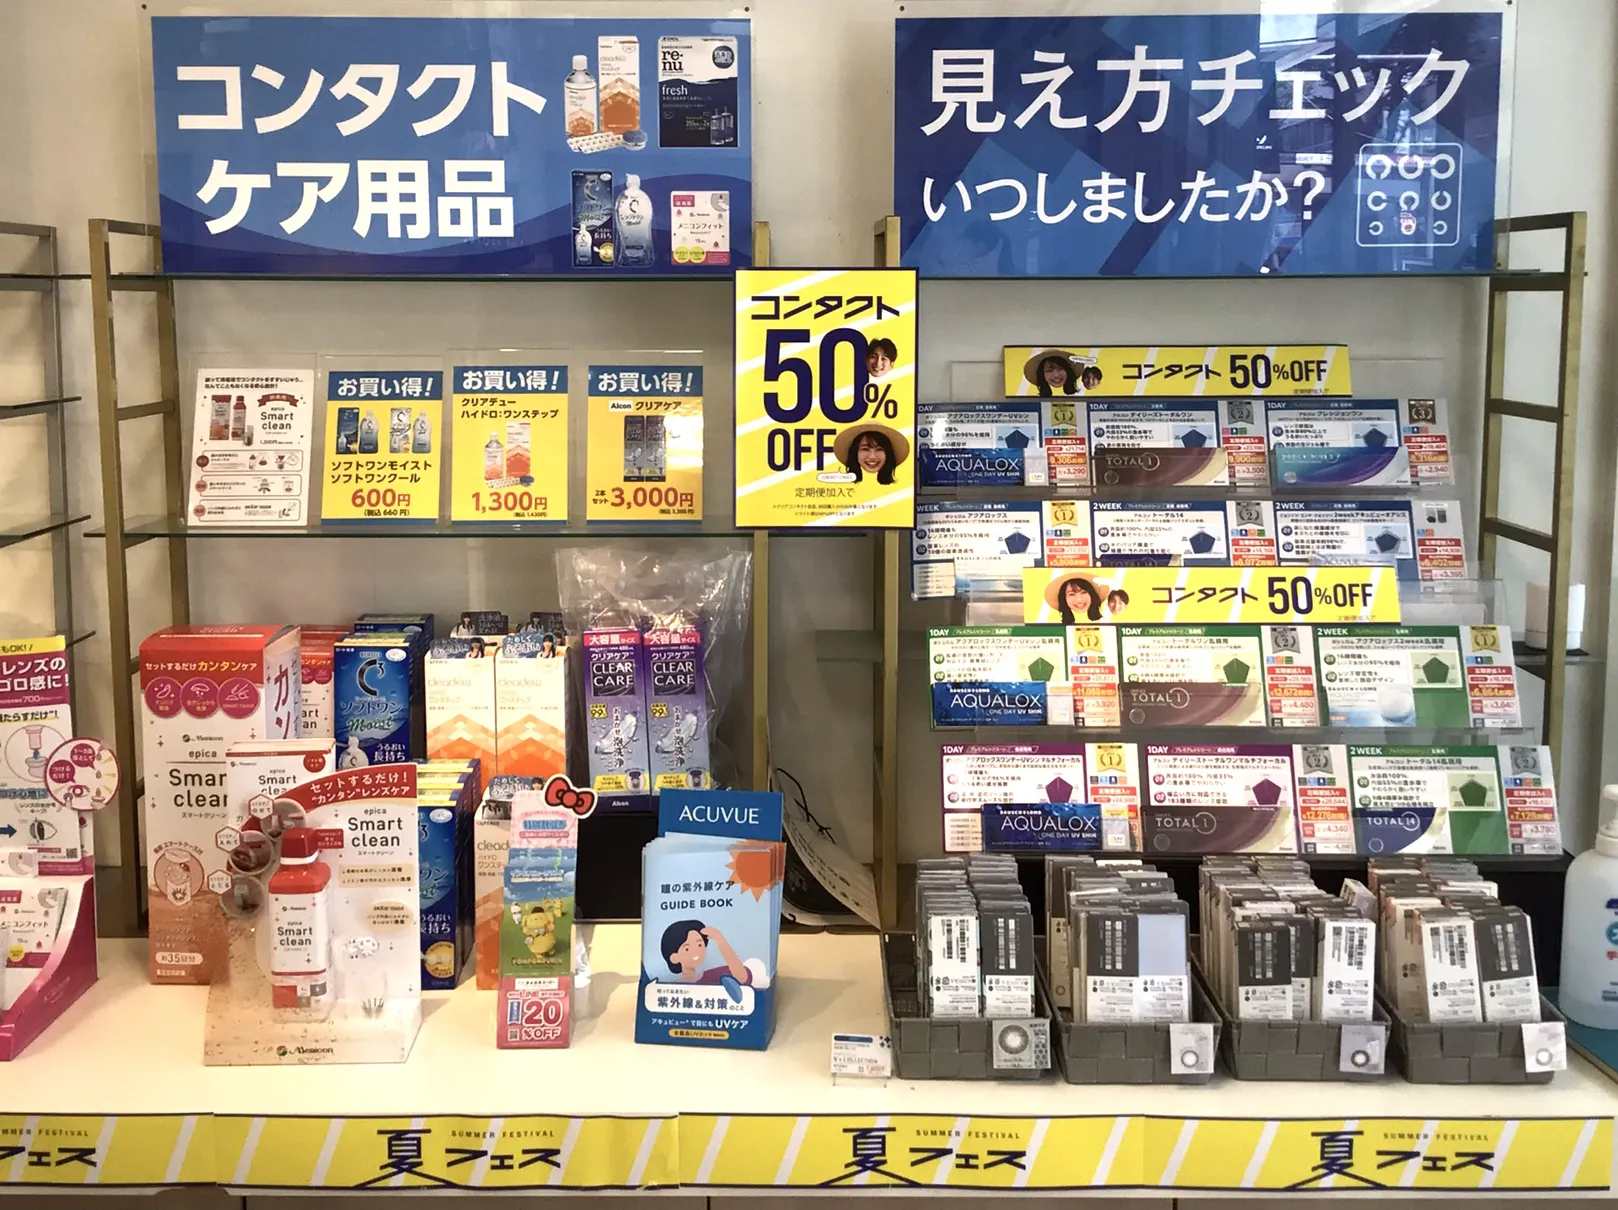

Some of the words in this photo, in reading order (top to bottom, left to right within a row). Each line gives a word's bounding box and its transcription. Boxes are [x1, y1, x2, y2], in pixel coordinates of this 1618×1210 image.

[661, 61, 684, 71] nu
[662, 84, 688, 95] fresh
[920, 44, 1469, 134] 見え方チェック
[176, 61, 547, 137] コンタクト
[195, 159, 514, 239] ケア用品
[923, 168, 1325, 223] いつしましたか?
[751, 295, 900, 320] コンタクト
[1122, 363, 1221, 380] コンタクト
[1229, 354, 1328, 390] 50%OFF
[463, 370, 559, 390] お買い得!
[598, 372, 693, 392] お買い得!
[338, 377, 433, 397] お買い得!
[461, 398, 516, 407] クリアデュー
[611, 402, 632, 410] Alcon
[635, 401, 682, 410] クリアケア
[261, 412, 293, 421] Smart
[767, 428, 836, 472] OFF
[331, 460, 432, 471] ソフトワンモイスト
[935, 458, 1020, 471] AQUALOX
[1106, 457, 1143, 465] TOTAL
[331, 473, 421, 483] ソフトワンクール
[351, 488, 410, 507] 600円
[611, 487, 694, 509] 3,000円
[795, 487, 854, 498] 定期便加入で
[471, 491, 547, 513] 1,300円
[917, 503, 939, 511] WEEK
[1093, 502, 1122, 510] 2WEEK
[1152, 586, 1258, 604] コンタクト
[1267, 576, 1373, 615] 50%OFF
[1122, 627, 1142, 635] 1DAY
[589, 633, 636, 645] 大容量サイズ
[649, 633, 697, 644] 大容量サイズ
[590, 652, 630, 661] クリアケア
[651, 652, 690, 660] クリアケア
[3, 657, 66, 676] レンズの
[145, 661, 258, 674] セットするだけカンタンケア
[592, 662, 633, 674] CLEAR
[653, 662, 694, 674] CLEAR
[427, 678, 472, 687] cleadew
[497, 678, 541, 687] cleadew
[593, 674, 634, 686] CARE
[654, 674, 695, 686] CARE
[22, 694, 41, 703] 700
[950, 693, 1042, 708] AQUALOX
[1132, 693, 1171, 703] TOTAL
[340, 701, 404, 717] ソフトワン
[346, 716, 394, 733] Moist
[376, 743, 406, 751] うるおい
[1147, 746, 1168, 754] 1DAY
[1350, 747, 1382, 755] 2WEEK
[189, 749, 217, 760] epica
[373, 751, 406, 762] 長持ち
[169, 768, 227, 787] Smar
[258, 773, 297, 785] Smart
[363, 807, 387, 816] epica
[679, 804, 760, 824] ACUVUE
[347, 816, 403, 832] Smart
[1001, 815, 1097, 831] AQUALOX
[1155, 817, 1197, 828] TOTAL
[1367, 817, 1404, 826] TOTAL
[1406, 817, 1415, 826] 14
[351, 833, 400, 848] clean
[477, 840, 509, 851] clead
[660, 879, 735, 894] 瞳の紫外線ケア
[660, 900, 695, 911] GUIDE
[700, 898, 734, 908] BOOK
[277, 926, 313, 936] Smart
[279, 937, 312, 946] clean
[525, 1000, 562, 1025] 20
[523, 1028, 561, 1040] %OFF
[1, 1128, 31, 1137] MMER
[38, 1128, 90, 1138] FESTIVAL
[450, 1129, 497, 1139] SUMMER
[502, 1129, 555, 1139] FESTIVAL
[916, 1128, 961, 1138] SUMMER
[966, 1130, 1021, 1139] FESTIVAL
[1383, 1132, 1429, 1141] SUMMER
[1435, 1133, 1490, 1142] FESTIVAL
